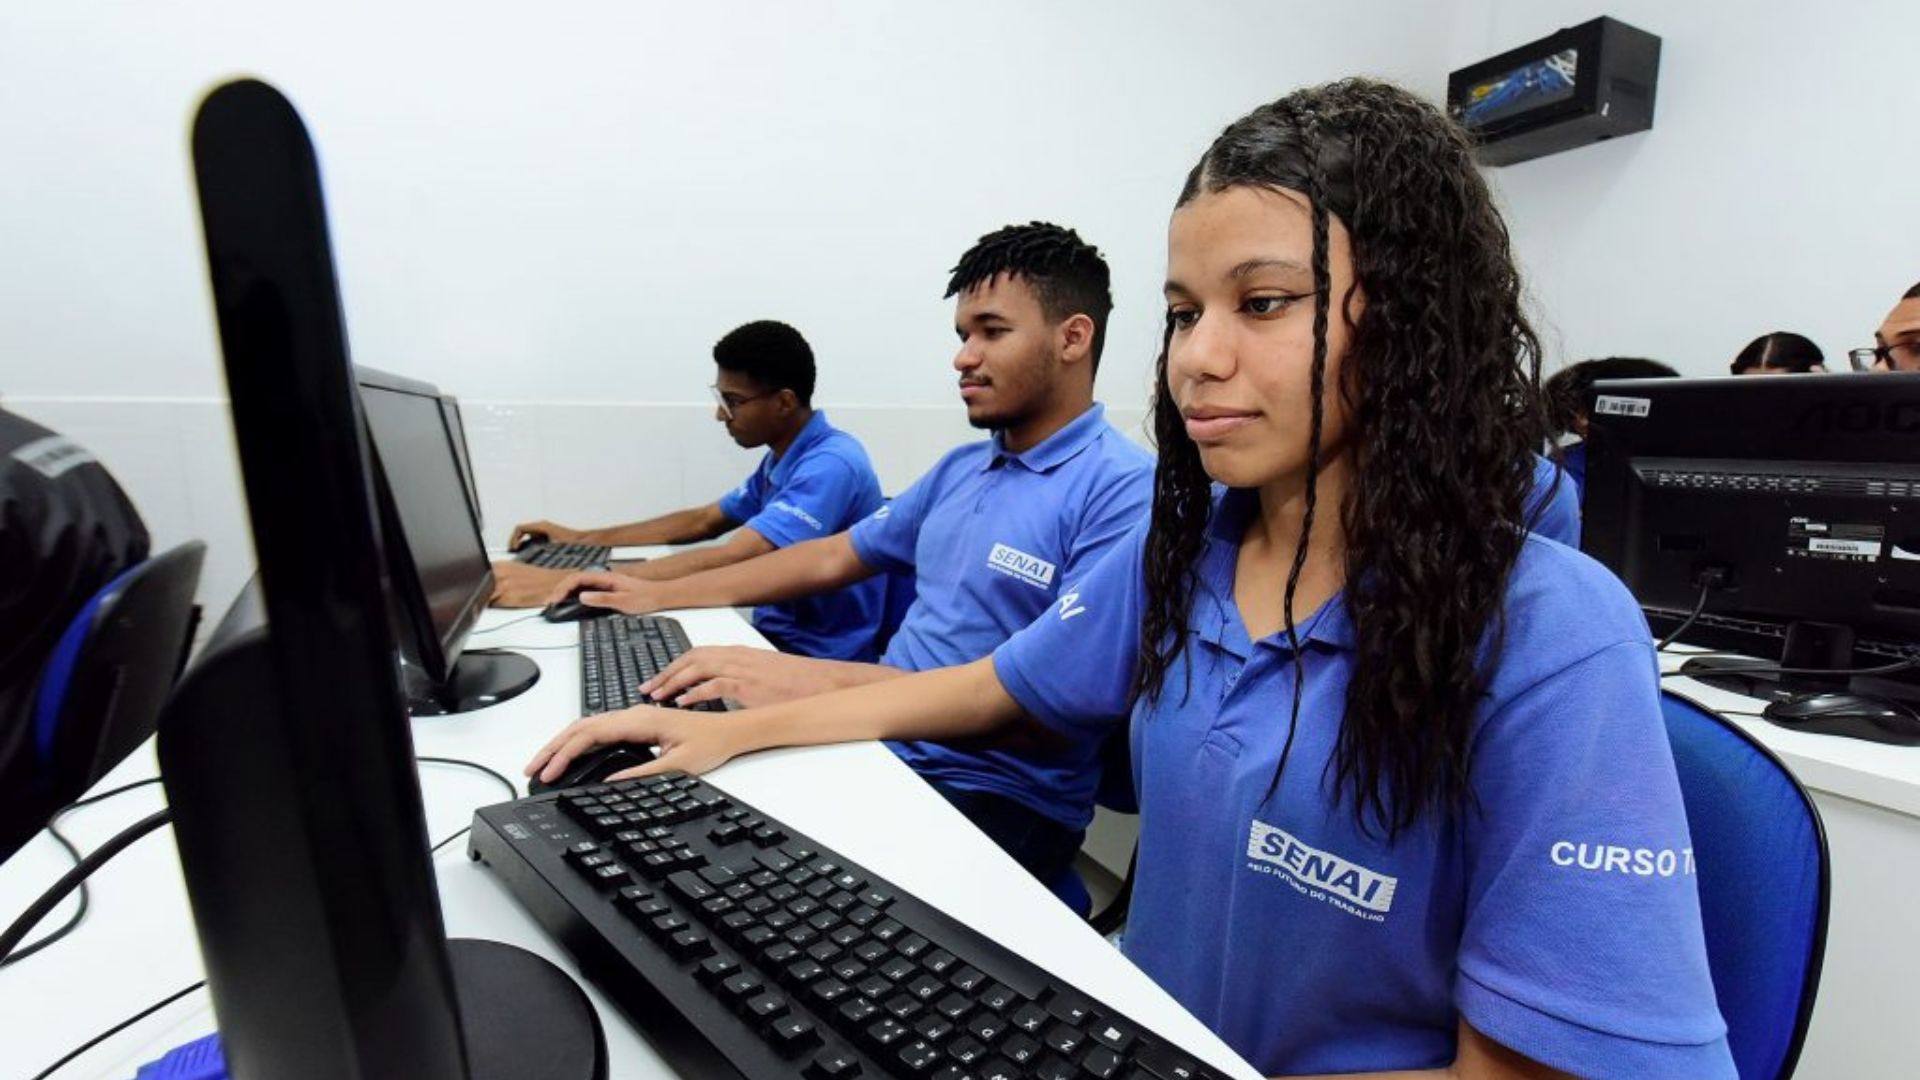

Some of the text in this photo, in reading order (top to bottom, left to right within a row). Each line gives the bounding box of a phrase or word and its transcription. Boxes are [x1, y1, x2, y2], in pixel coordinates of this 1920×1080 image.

[995, 548, 1048, 578] SENAI
[1260, 832, 1382, 903] SENAI
[1551, 841, 1696, 877] CURSO T
[1310, 889, 1326, 901] DO
